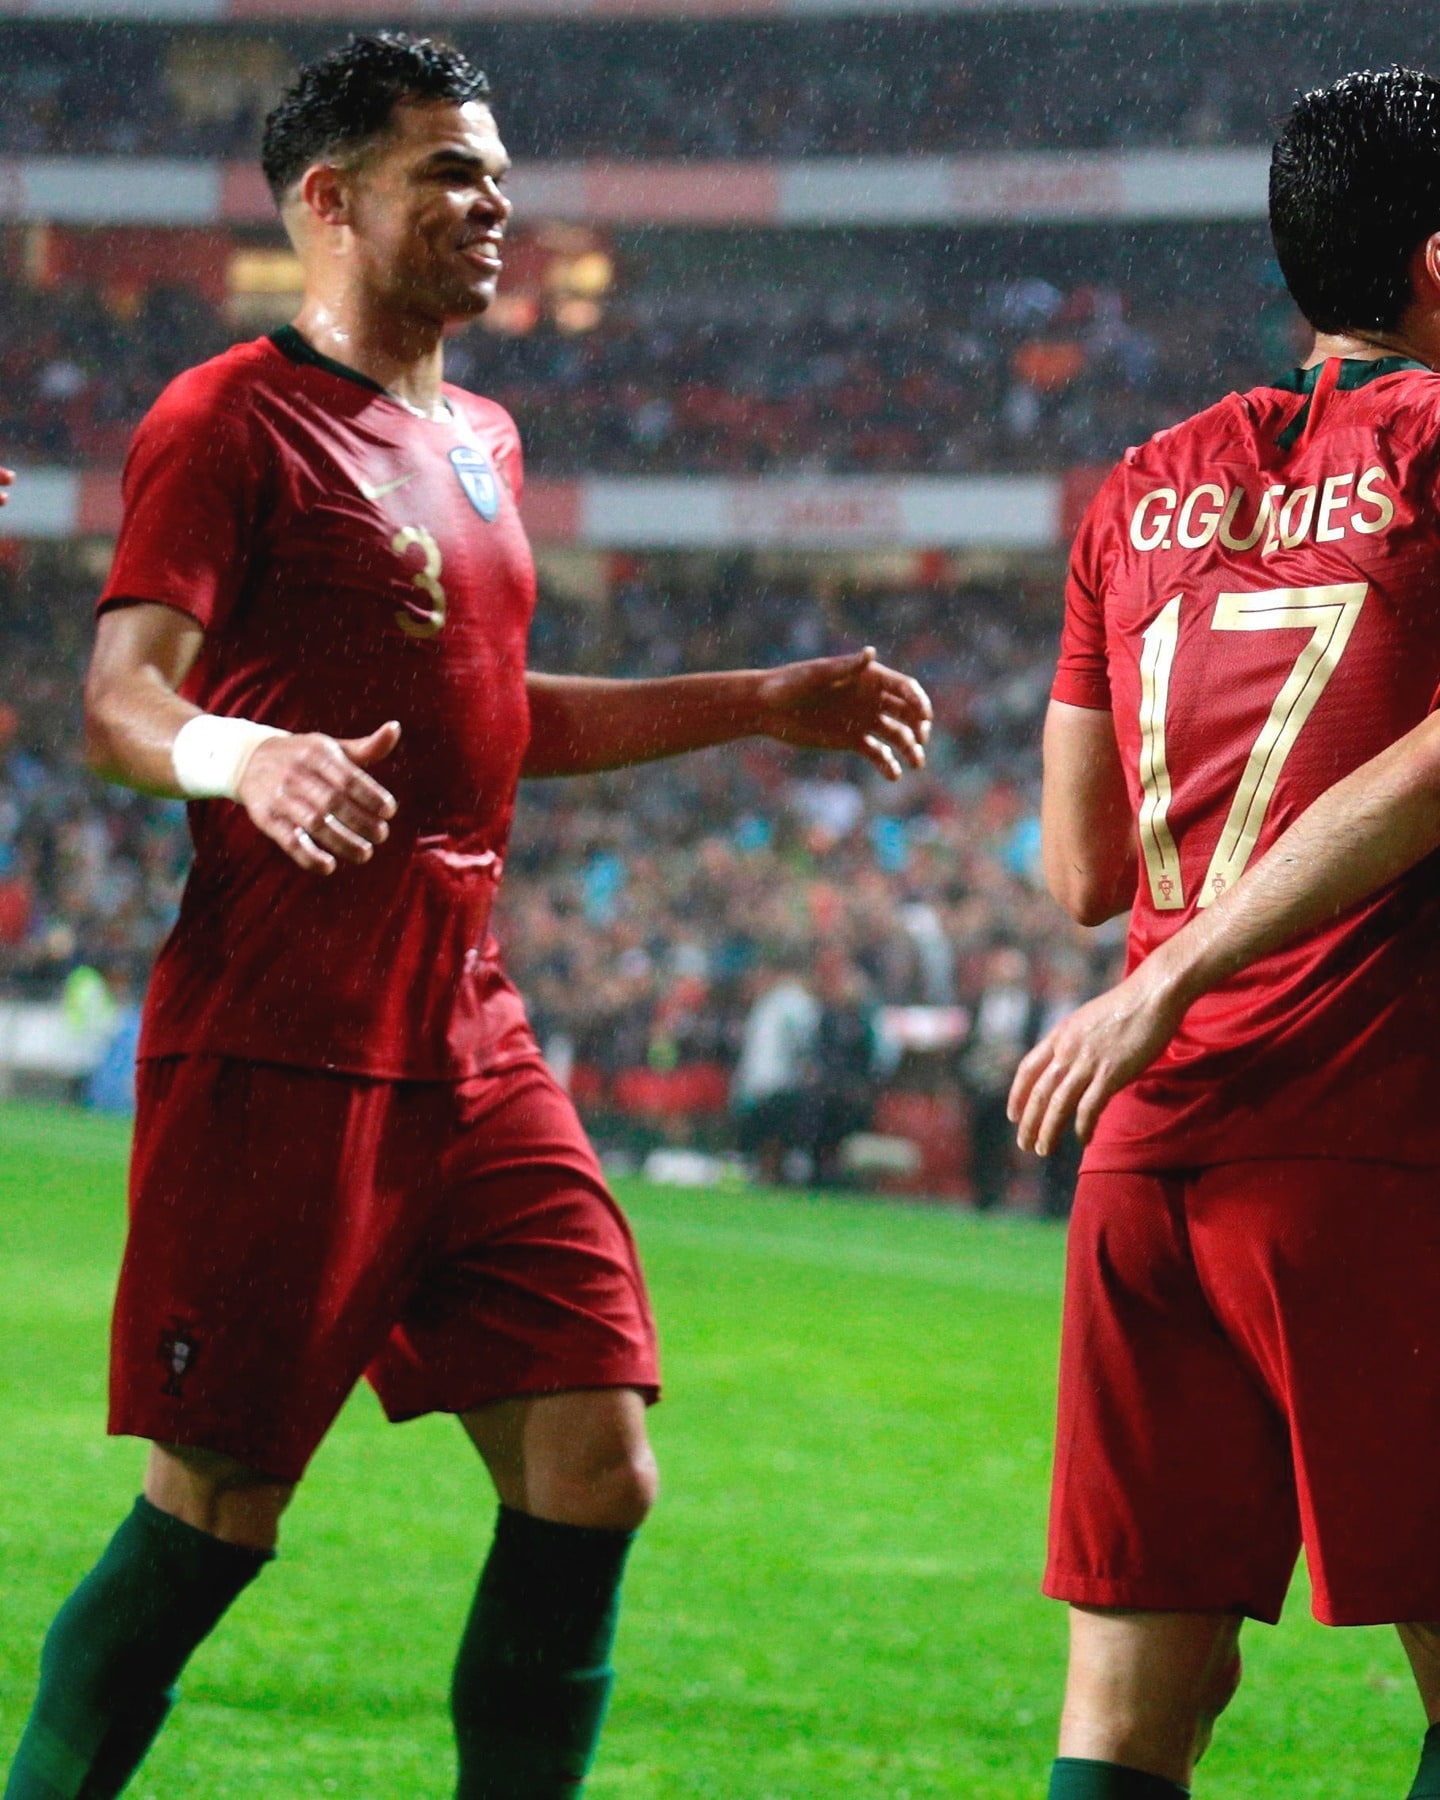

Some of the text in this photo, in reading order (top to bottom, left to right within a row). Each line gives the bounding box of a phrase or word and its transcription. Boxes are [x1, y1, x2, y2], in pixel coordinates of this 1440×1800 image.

[1129, 466, 1395, 557] G.GUEDES
[391, 526, 446, 638] 3
[1138, 582, 1368, 910] 17
